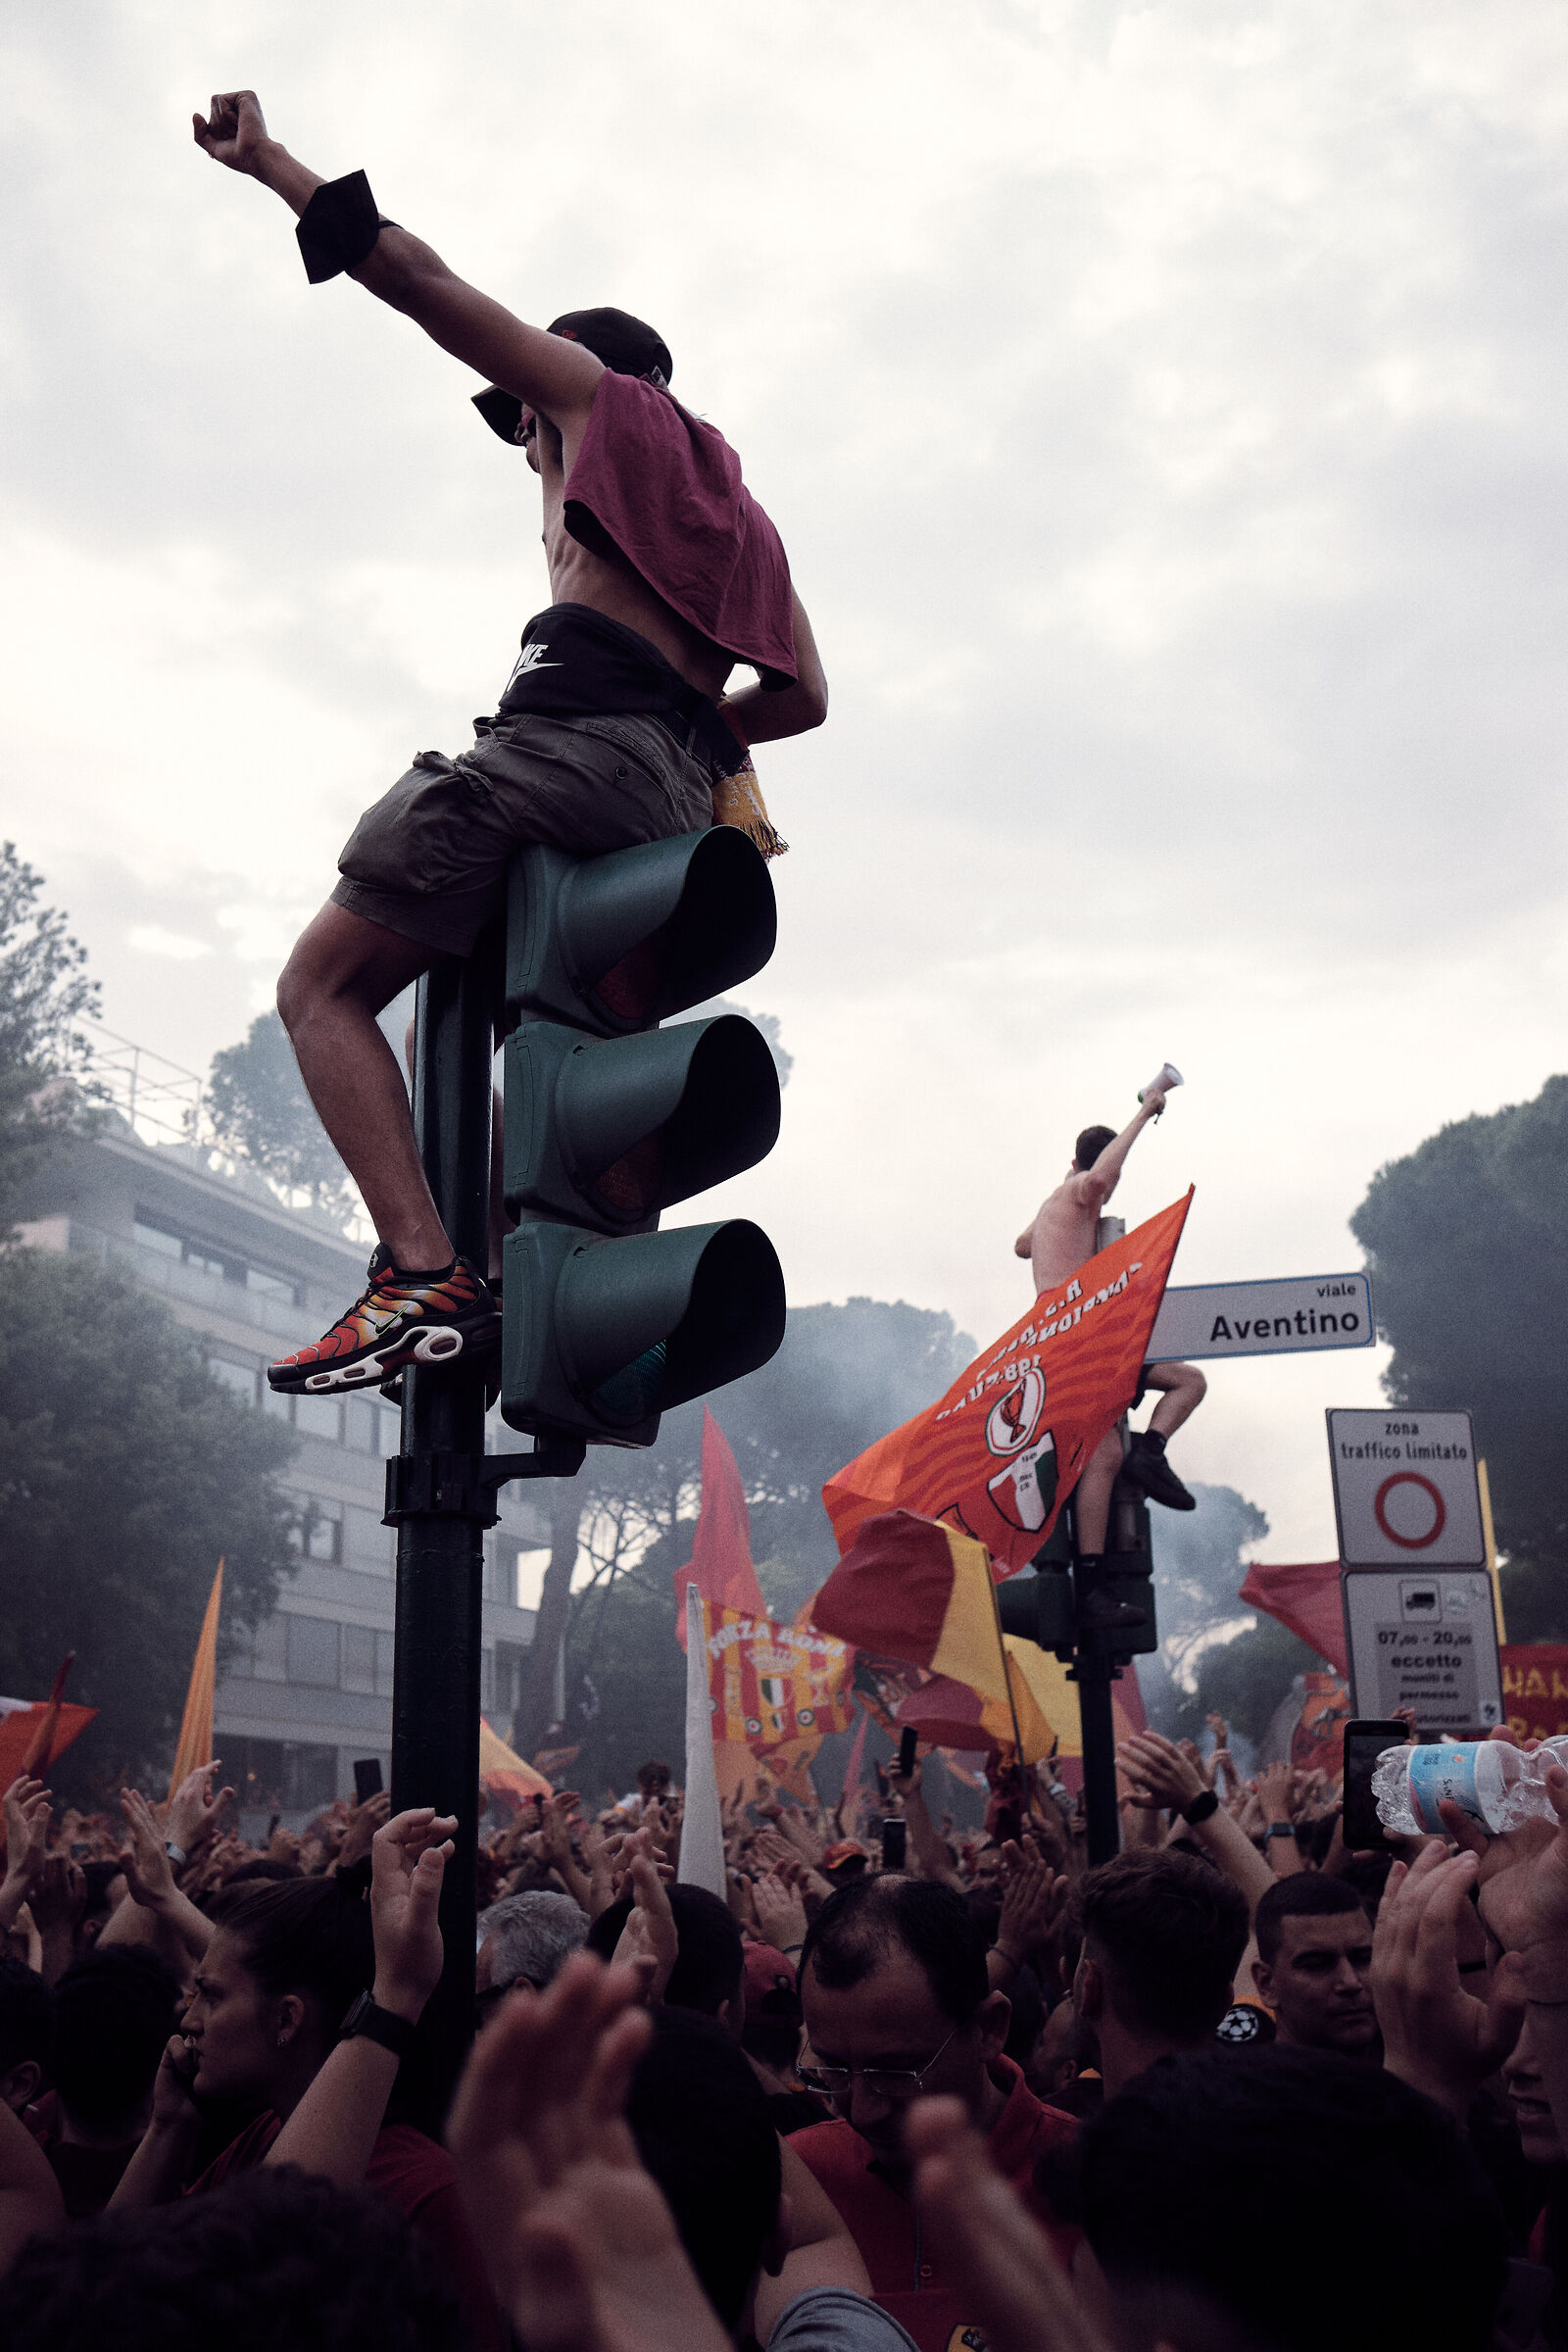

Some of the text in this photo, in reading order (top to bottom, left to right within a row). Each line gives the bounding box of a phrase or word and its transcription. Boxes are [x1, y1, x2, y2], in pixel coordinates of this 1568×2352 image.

[1317, 1283, 1357, 1298] viale
[1209, 1308, 1359, 1342] Aventino
[1385, 1422, 1420, 1436] zona
[1342, 1442, 1468, 1459] traffico limitato
[708, 1620, 771, 1659] FORZA
[1391, 1654, 1462, 1668] eccetto
[1398, 1690, 1460, 1702] permesso
